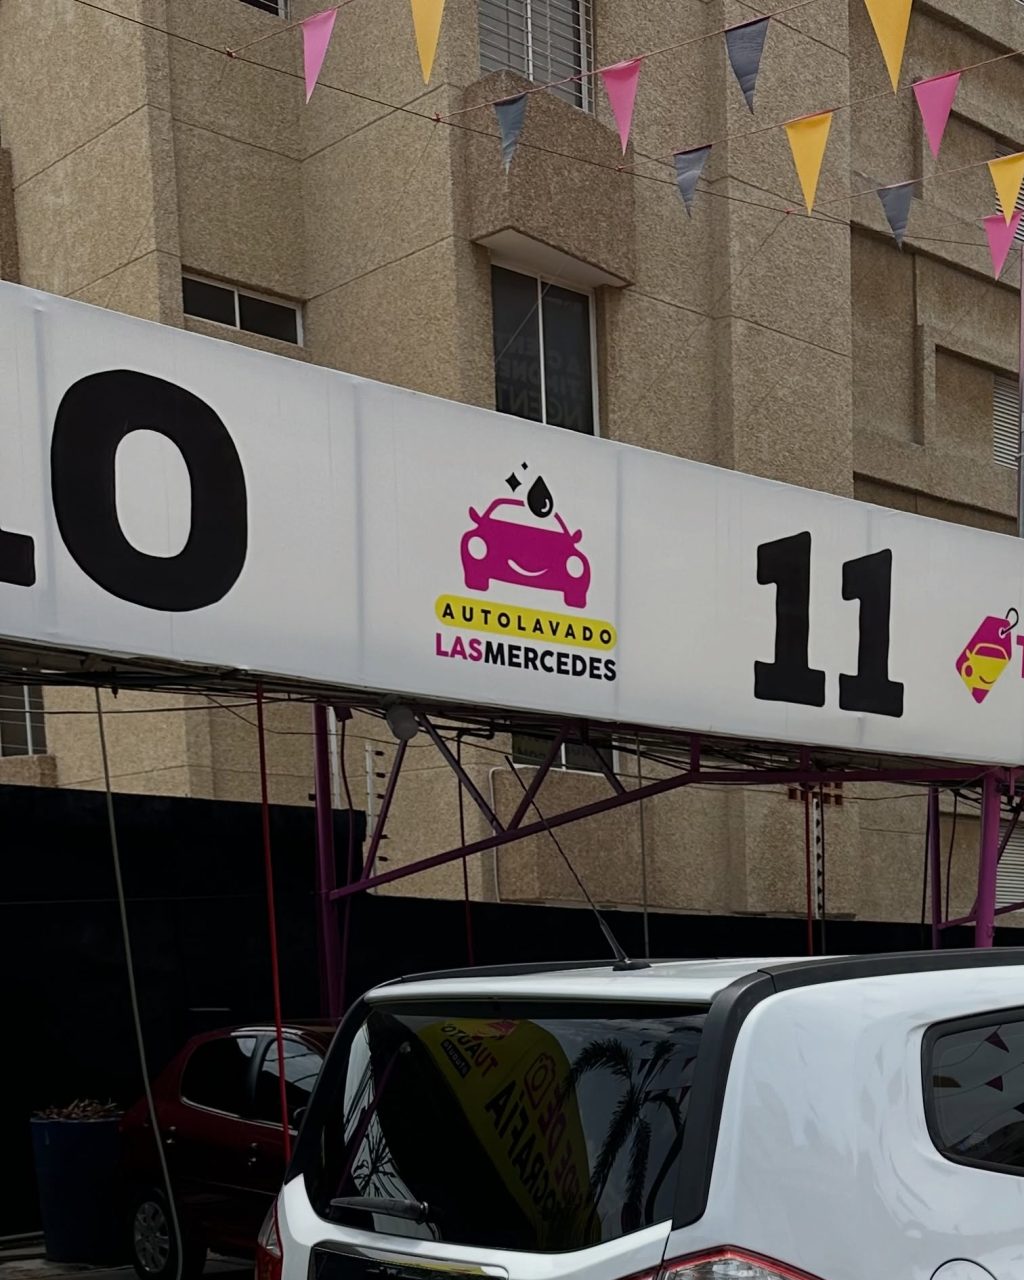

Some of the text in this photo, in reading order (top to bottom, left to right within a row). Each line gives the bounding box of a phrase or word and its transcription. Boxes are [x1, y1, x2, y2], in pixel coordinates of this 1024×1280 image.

[0, 368, 248, 612] 0
[435, 632, 617, 682] LASMERCEDES
[441, 602, 613, 645] AUTOLAVADO
[753, 531, 904, 718] 11
